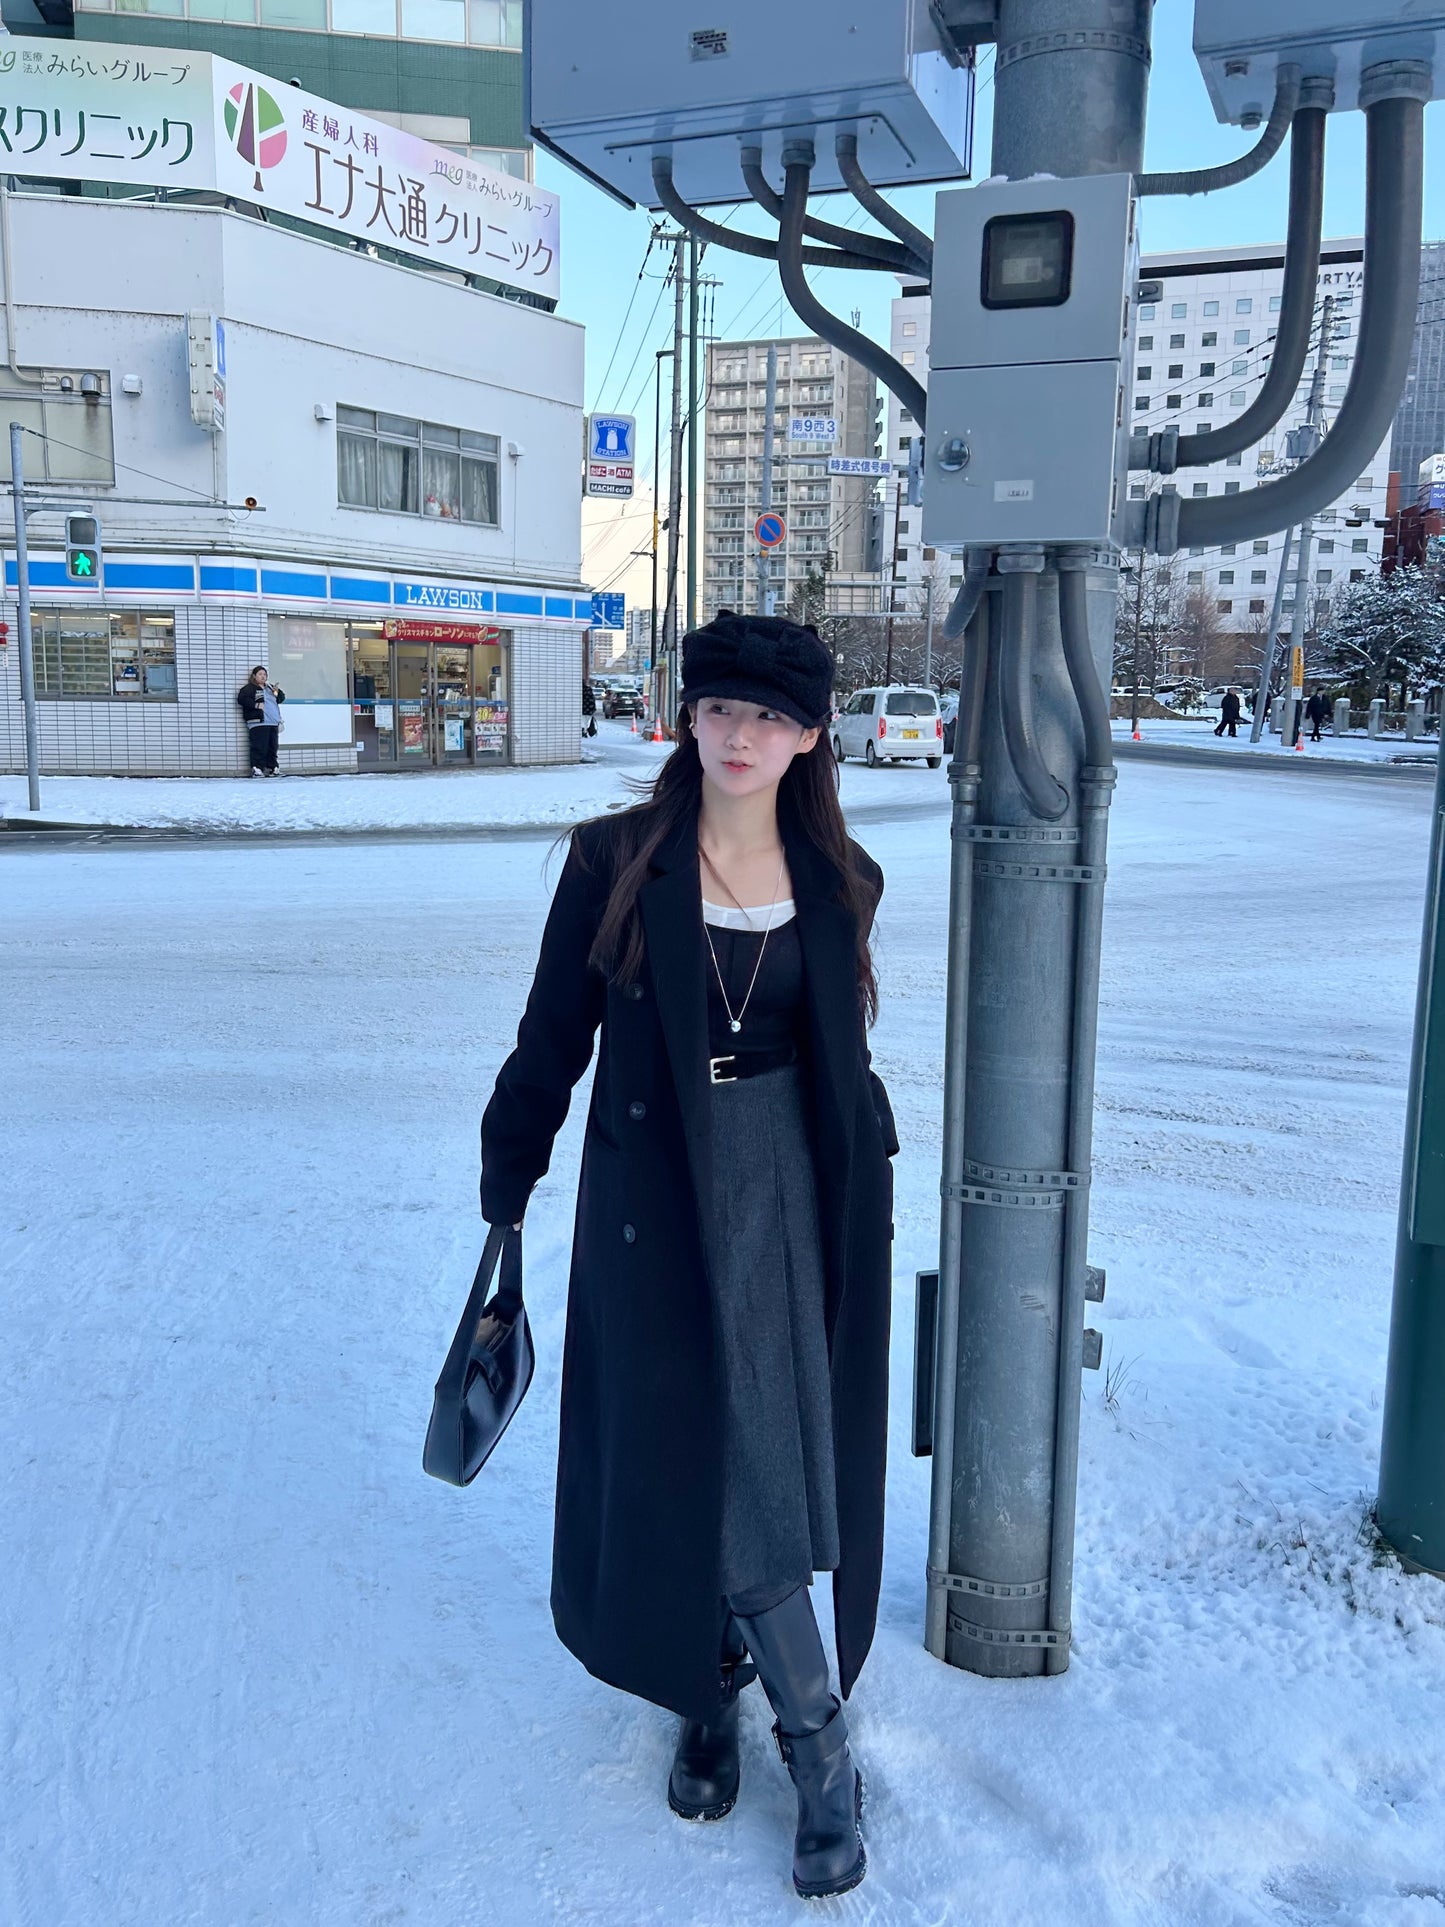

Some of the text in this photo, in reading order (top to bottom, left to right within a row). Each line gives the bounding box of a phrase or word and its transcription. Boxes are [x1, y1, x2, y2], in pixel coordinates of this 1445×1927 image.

[23, 63, 43, 74] 法人
[47, 54, 191, 85] みらいグループ
[302, 108, 379, 157] 産婦人科
[429, 159, 463, 186] meg
[479, 177, 553, 218] みらいグループ
[303, 141, 553, 276] エナ大通クリニック
[597, 420, 629, 431] LAWSON
[791, 419, 836, 432] 南9西3
[596, 447, 627, 457] STATION
[616, 468, 632, 478] ATM
[830, 460, 891, 473] 時差式信号機
[591, 484, 631, 494] MACHI café
[406, 585, 483, 609] LAWSON
